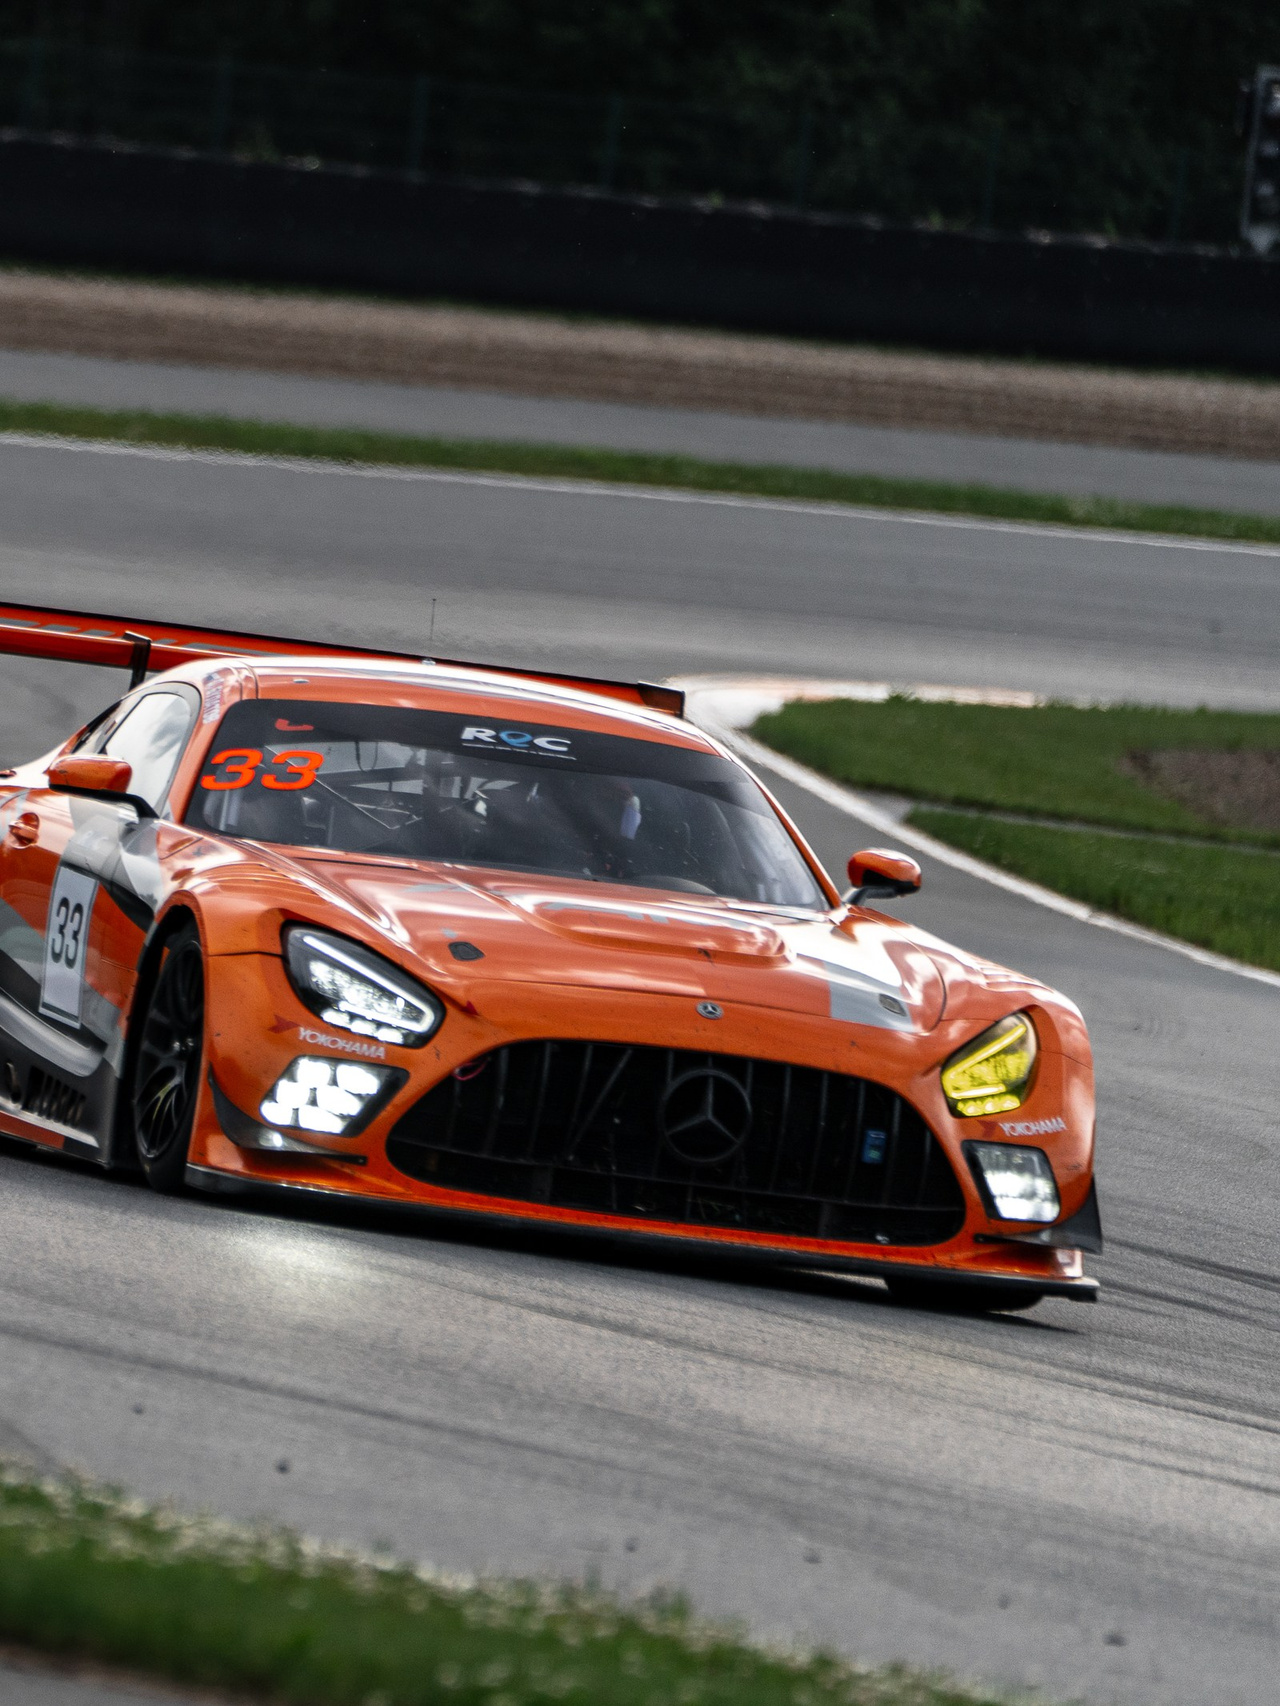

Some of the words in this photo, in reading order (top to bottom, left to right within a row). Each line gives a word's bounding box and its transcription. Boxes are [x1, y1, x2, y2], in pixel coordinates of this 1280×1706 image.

[200, 748, 324, 791] 33
[51, 896, 84, 970] 33
[298, 1026, 386, 1060] YOKOHAMA
[998, 1115, 1067, 1137] YOKOHAMA
